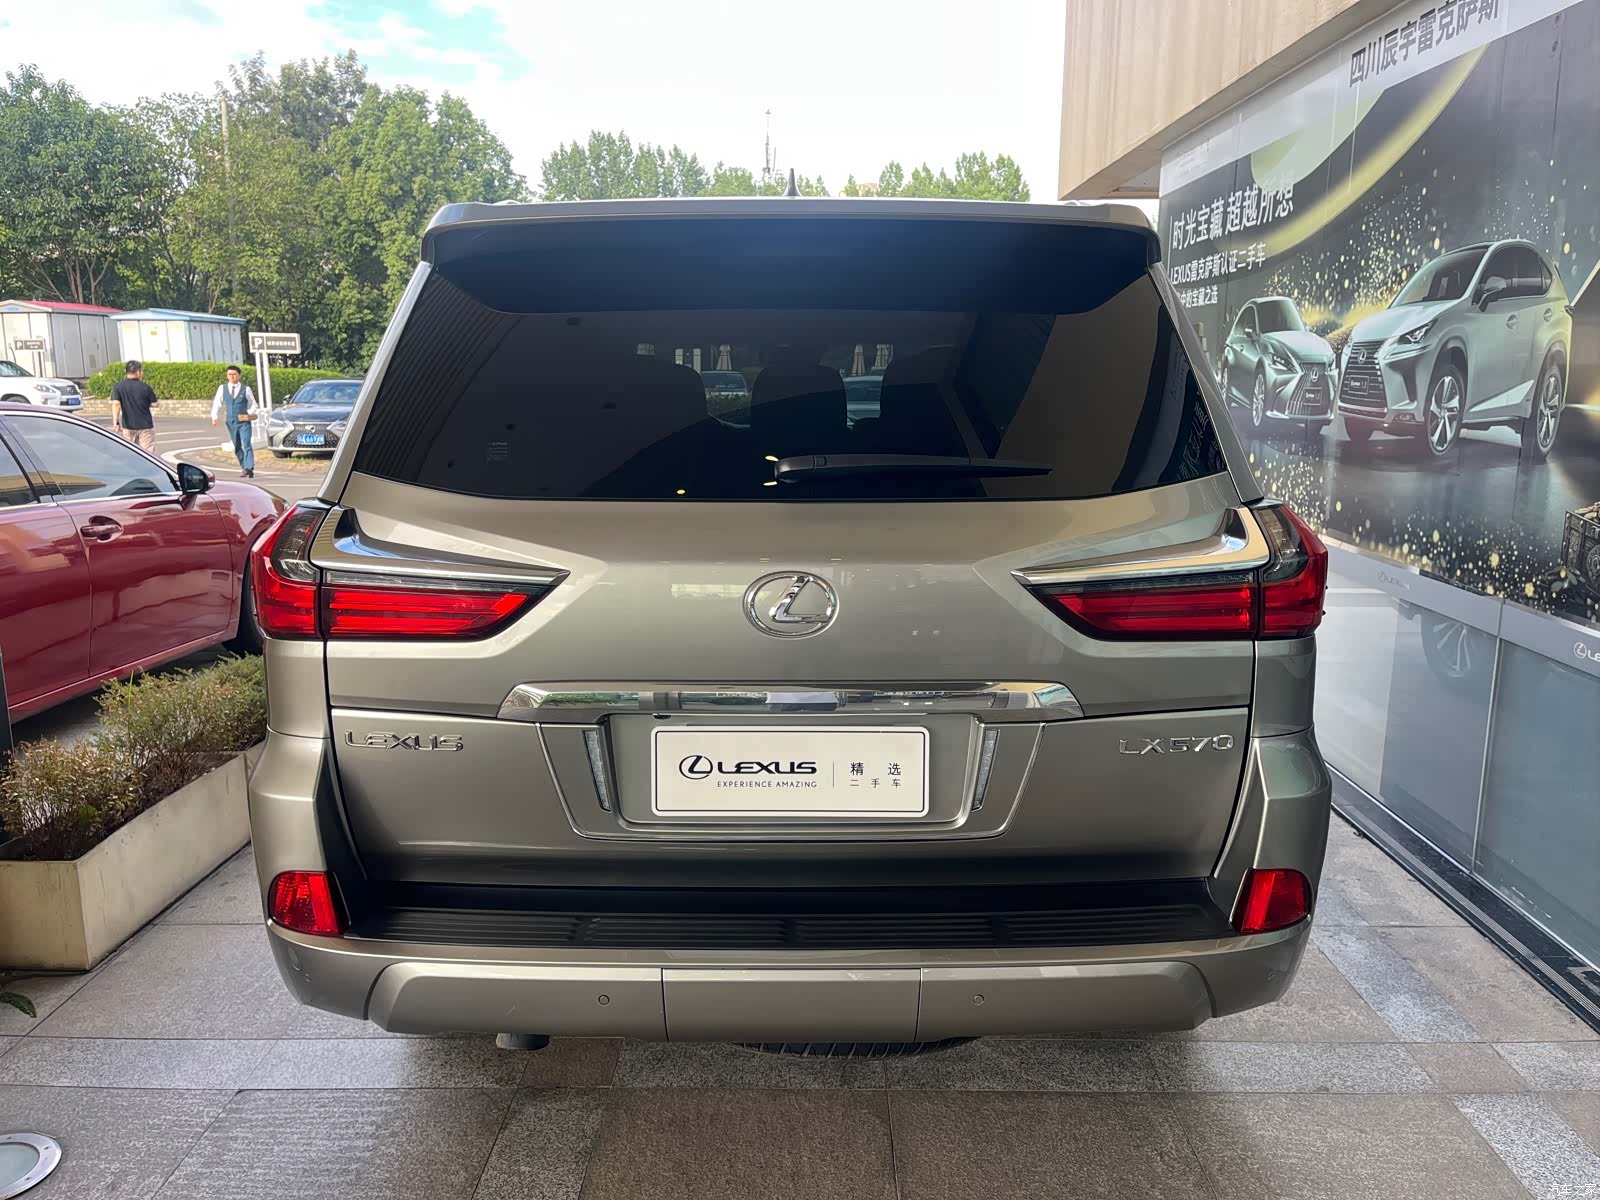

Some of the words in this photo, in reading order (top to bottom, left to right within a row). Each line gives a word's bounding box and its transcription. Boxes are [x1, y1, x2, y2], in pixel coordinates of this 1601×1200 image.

[1172, 197, 1225, 250] 时光宝藏
[254, 338, 263, 348] P
[344, 729, 464, 751] LEXUS
[1119, 738, 1165, 755] LX
[1169, 734, 1234, 753] 570
[717, 761, 818, 775] LEXUS
